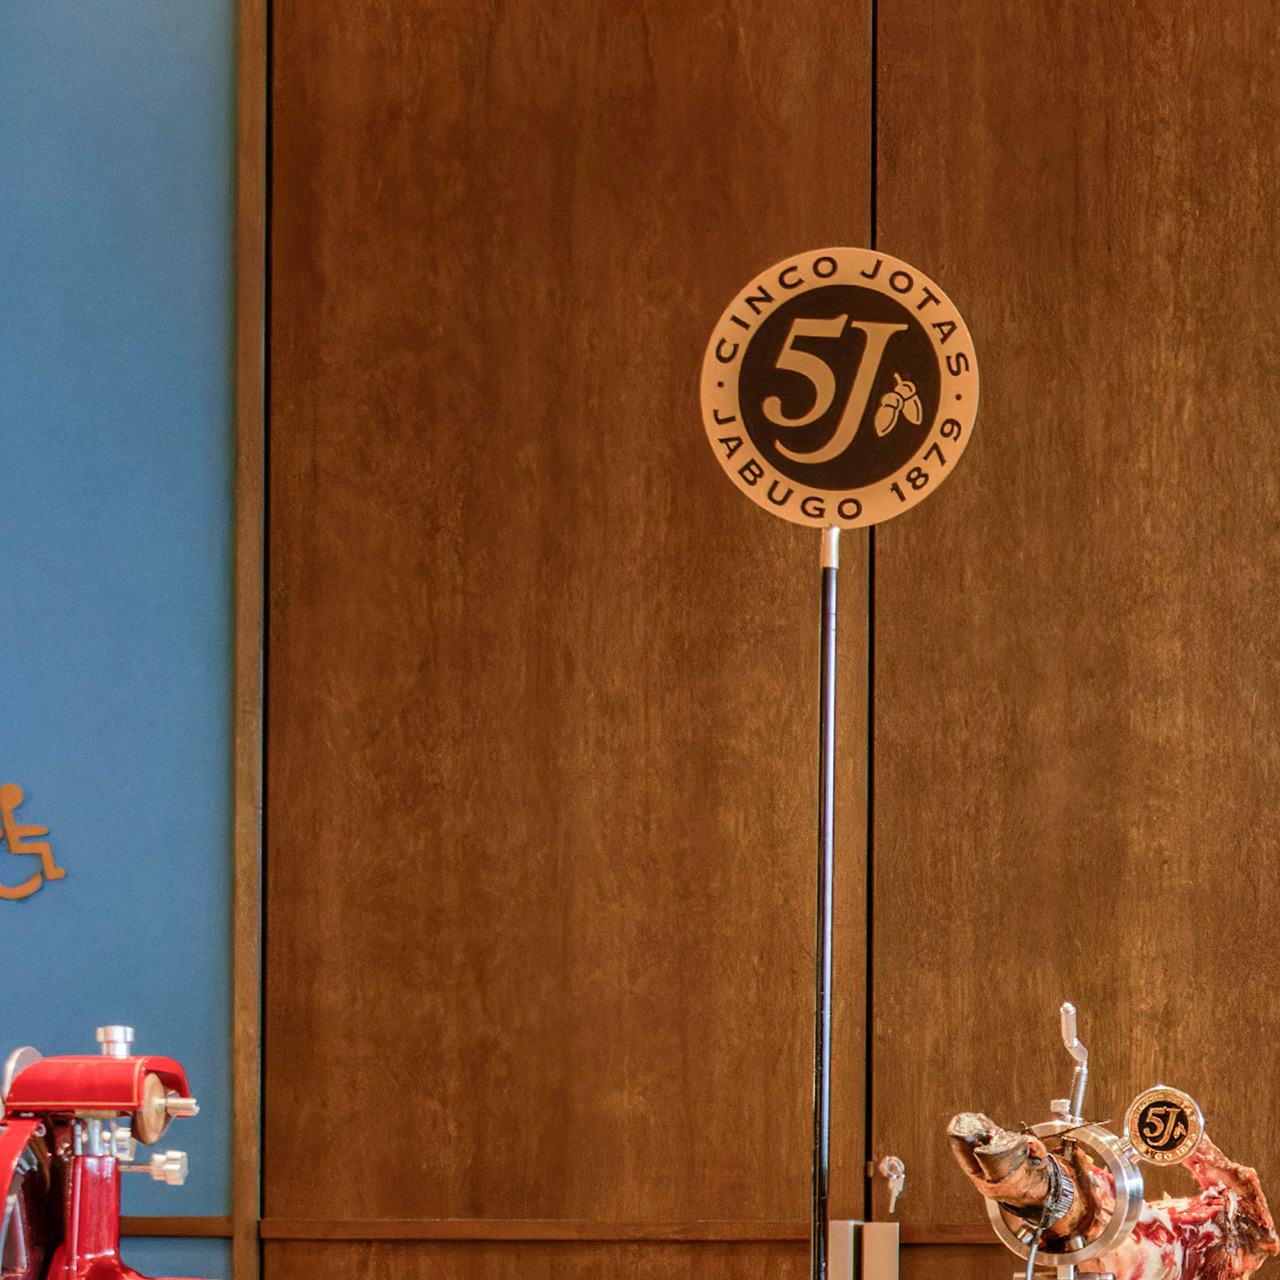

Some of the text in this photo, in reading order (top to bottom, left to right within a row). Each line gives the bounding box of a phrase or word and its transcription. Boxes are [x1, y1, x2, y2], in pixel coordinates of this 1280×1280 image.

[715, 256, 970, 377] CINCO JOTAS
[761, 313, 908, 465] 5J
[713, 409, 962, 520] JABUGO 1879
[1142, 1106, 1181, 1146] 5J
